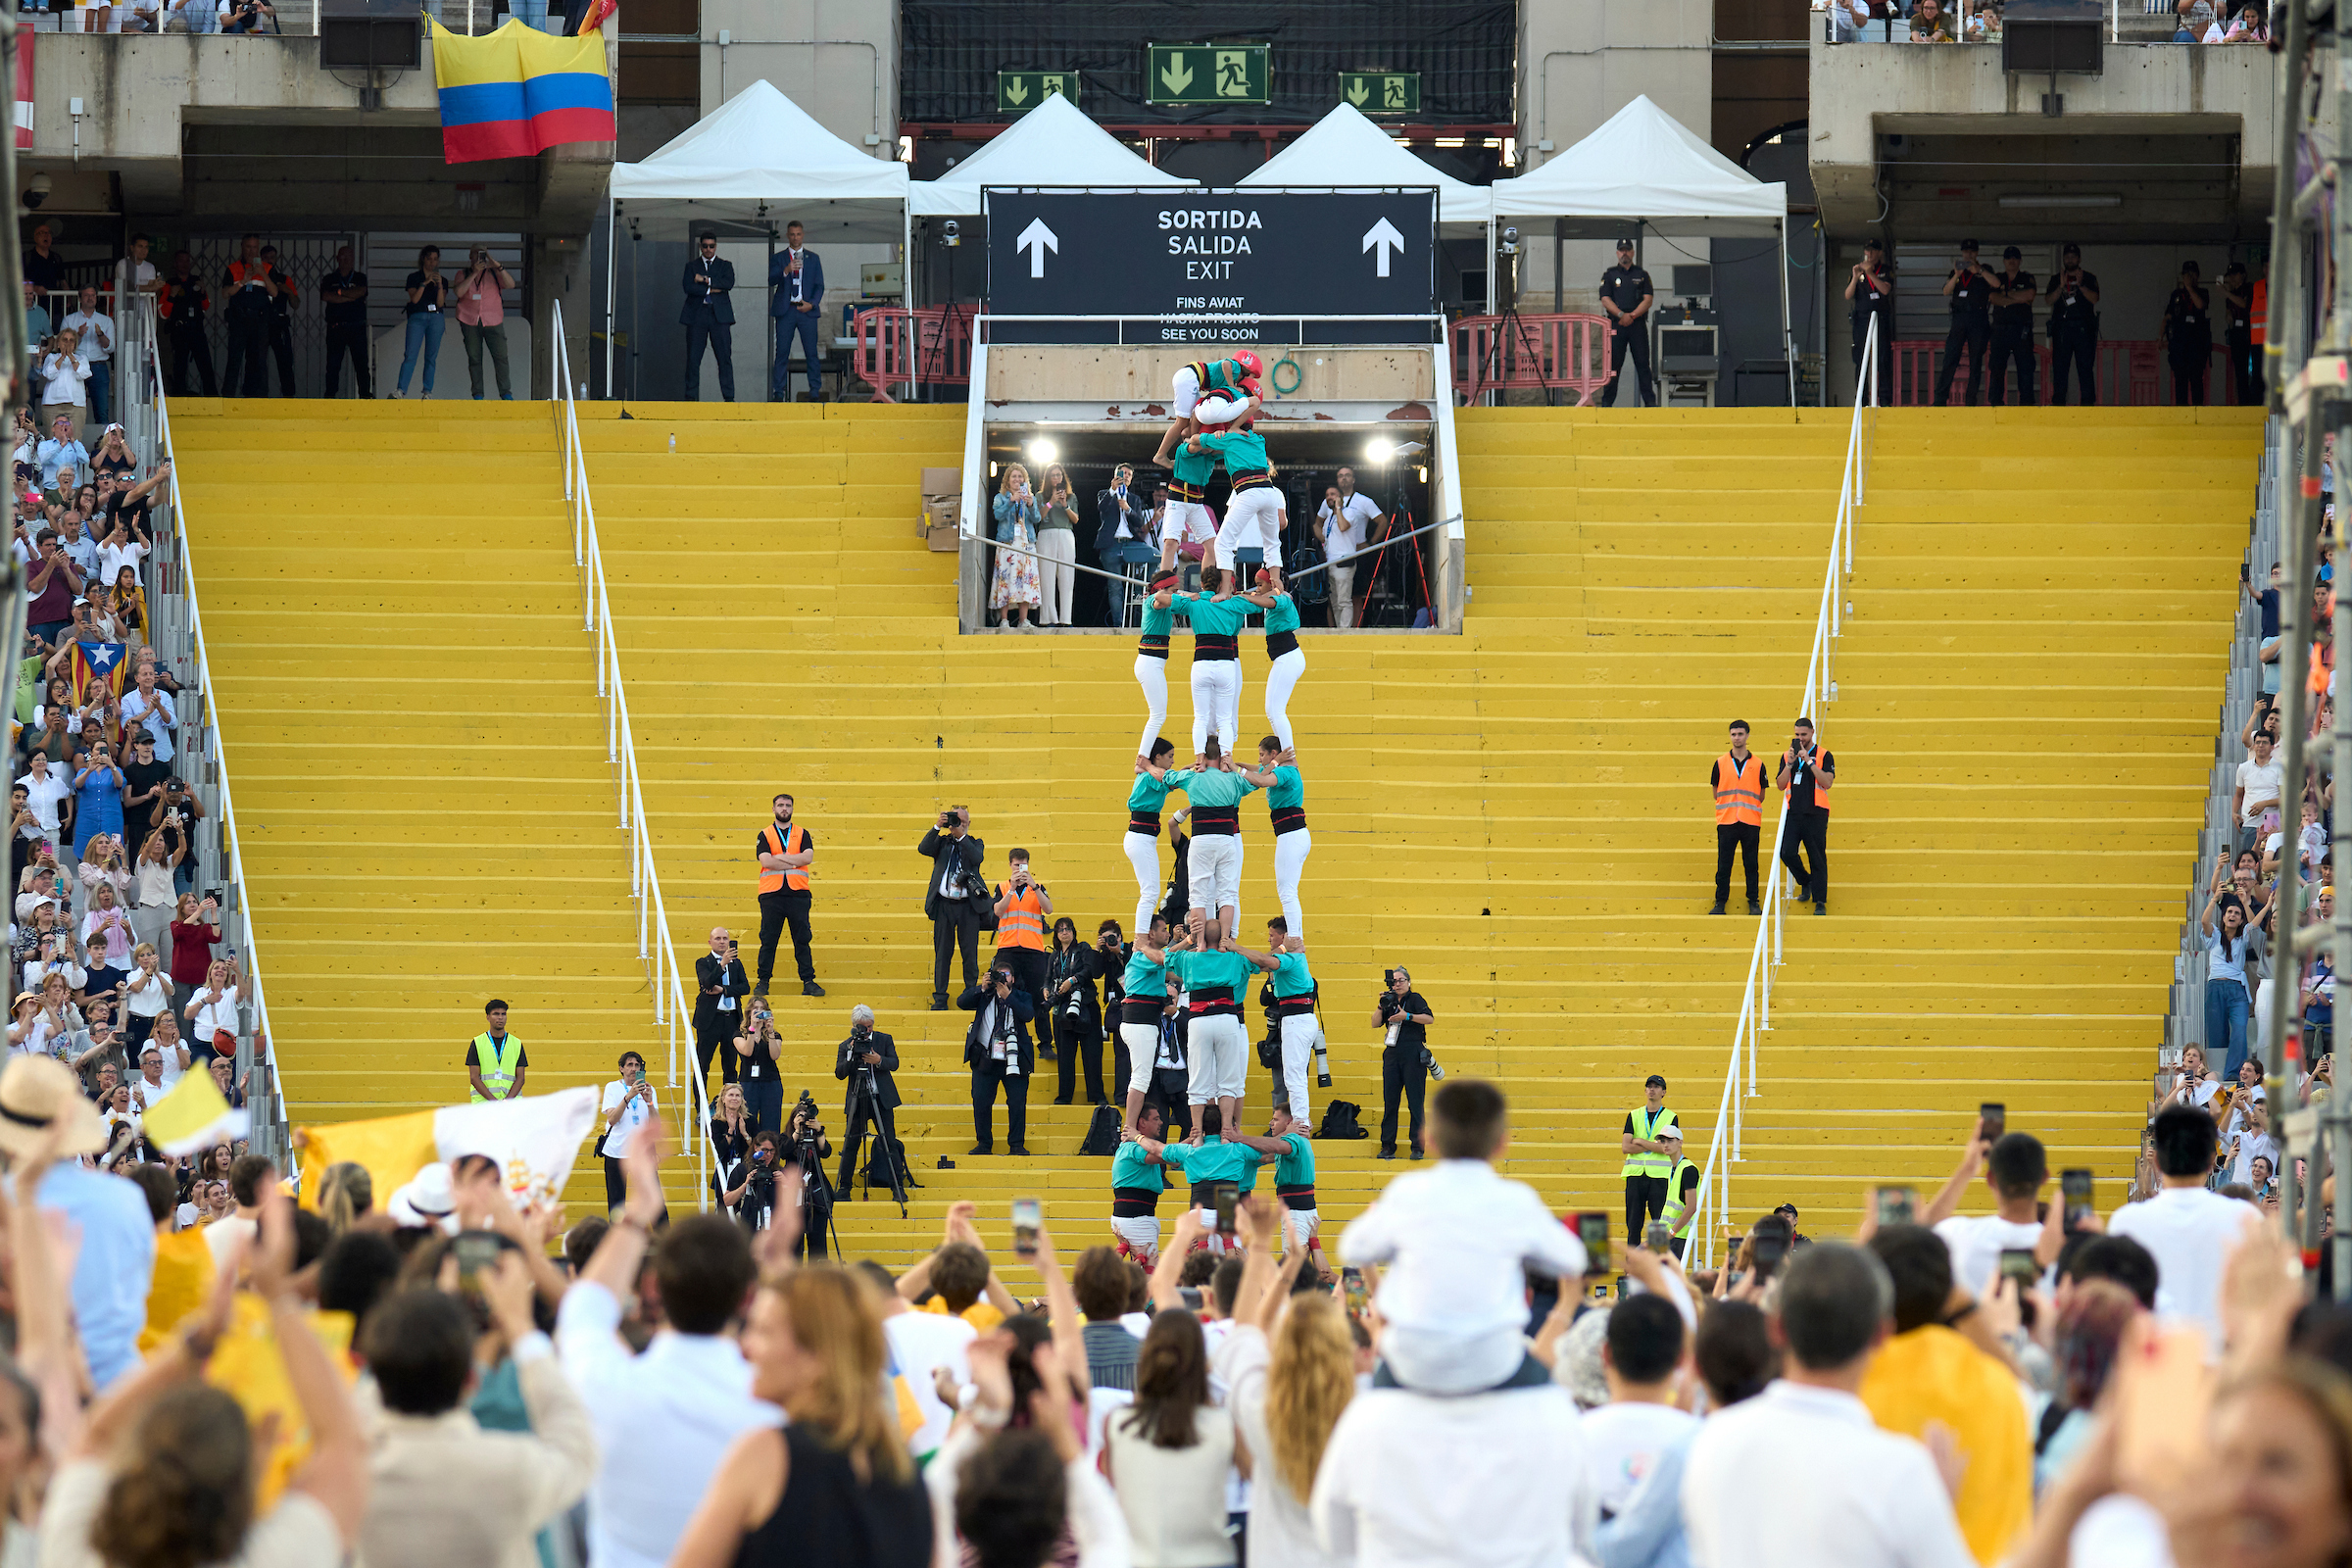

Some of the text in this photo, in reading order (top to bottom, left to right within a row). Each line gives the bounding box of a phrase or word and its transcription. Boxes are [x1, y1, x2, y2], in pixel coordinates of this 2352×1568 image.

[1157, 210, 1263, 230] SORTIDA
[1168, 235, 1252, 255] SALIDA
[1186, 261, 1235, 280] EXIT
[1176, 297, 1245, 309] FINS AVIAT
[1161, 328, 1259, 341] SEE YOU SOON
